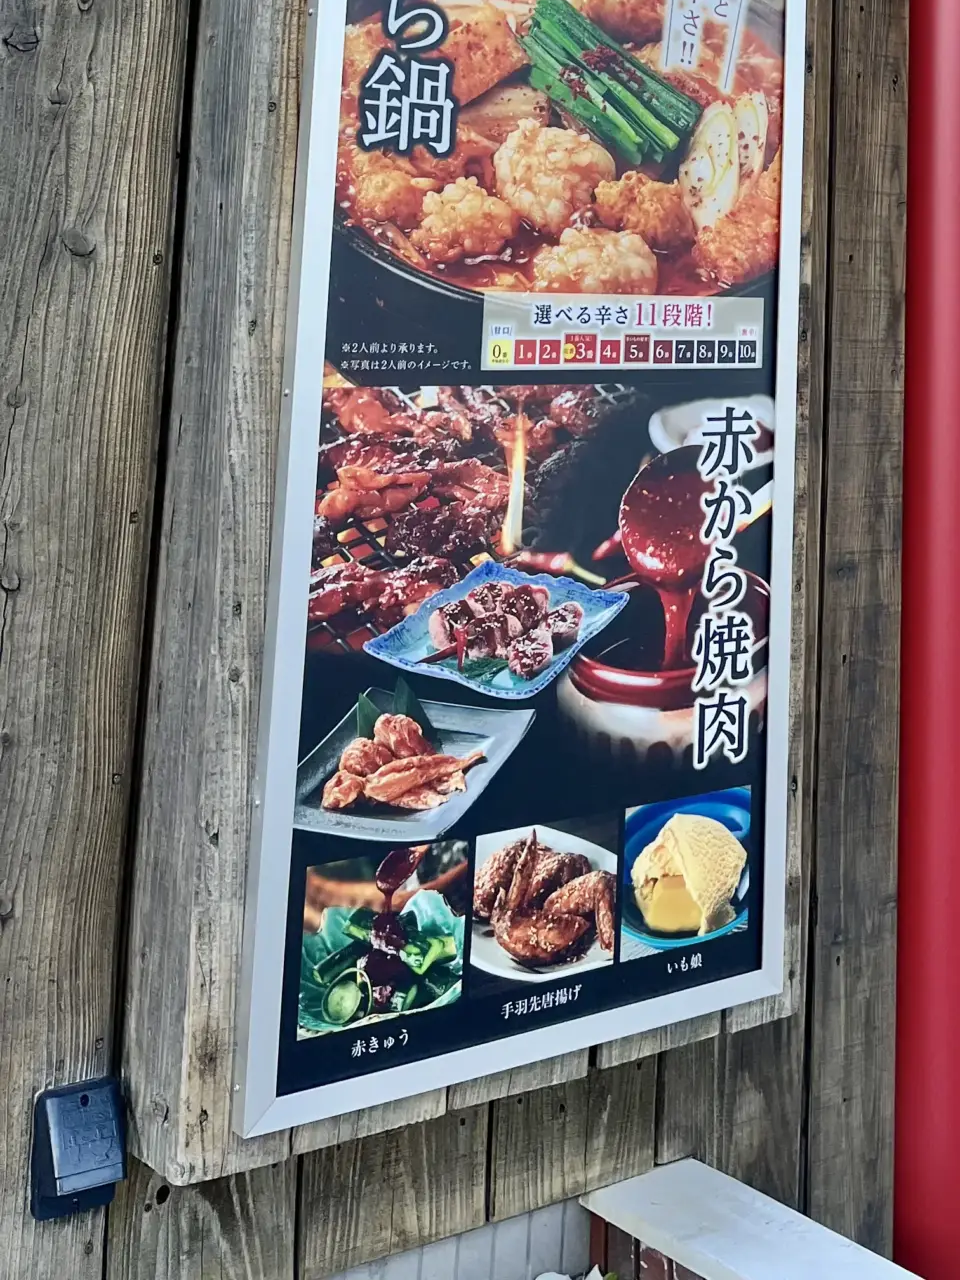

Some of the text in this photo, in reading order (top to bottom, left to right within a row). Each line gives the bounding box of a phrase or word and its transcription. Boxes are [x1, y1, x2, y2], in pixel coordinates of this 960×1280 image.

[696, 406, 757, 765] 赤から焼肉
[666, 953, 703, 975] いも娘
[500, 984, 582, 1020] 手羽先唐揚げ
[350, 1028, 410, 1058] 赤きゅう
